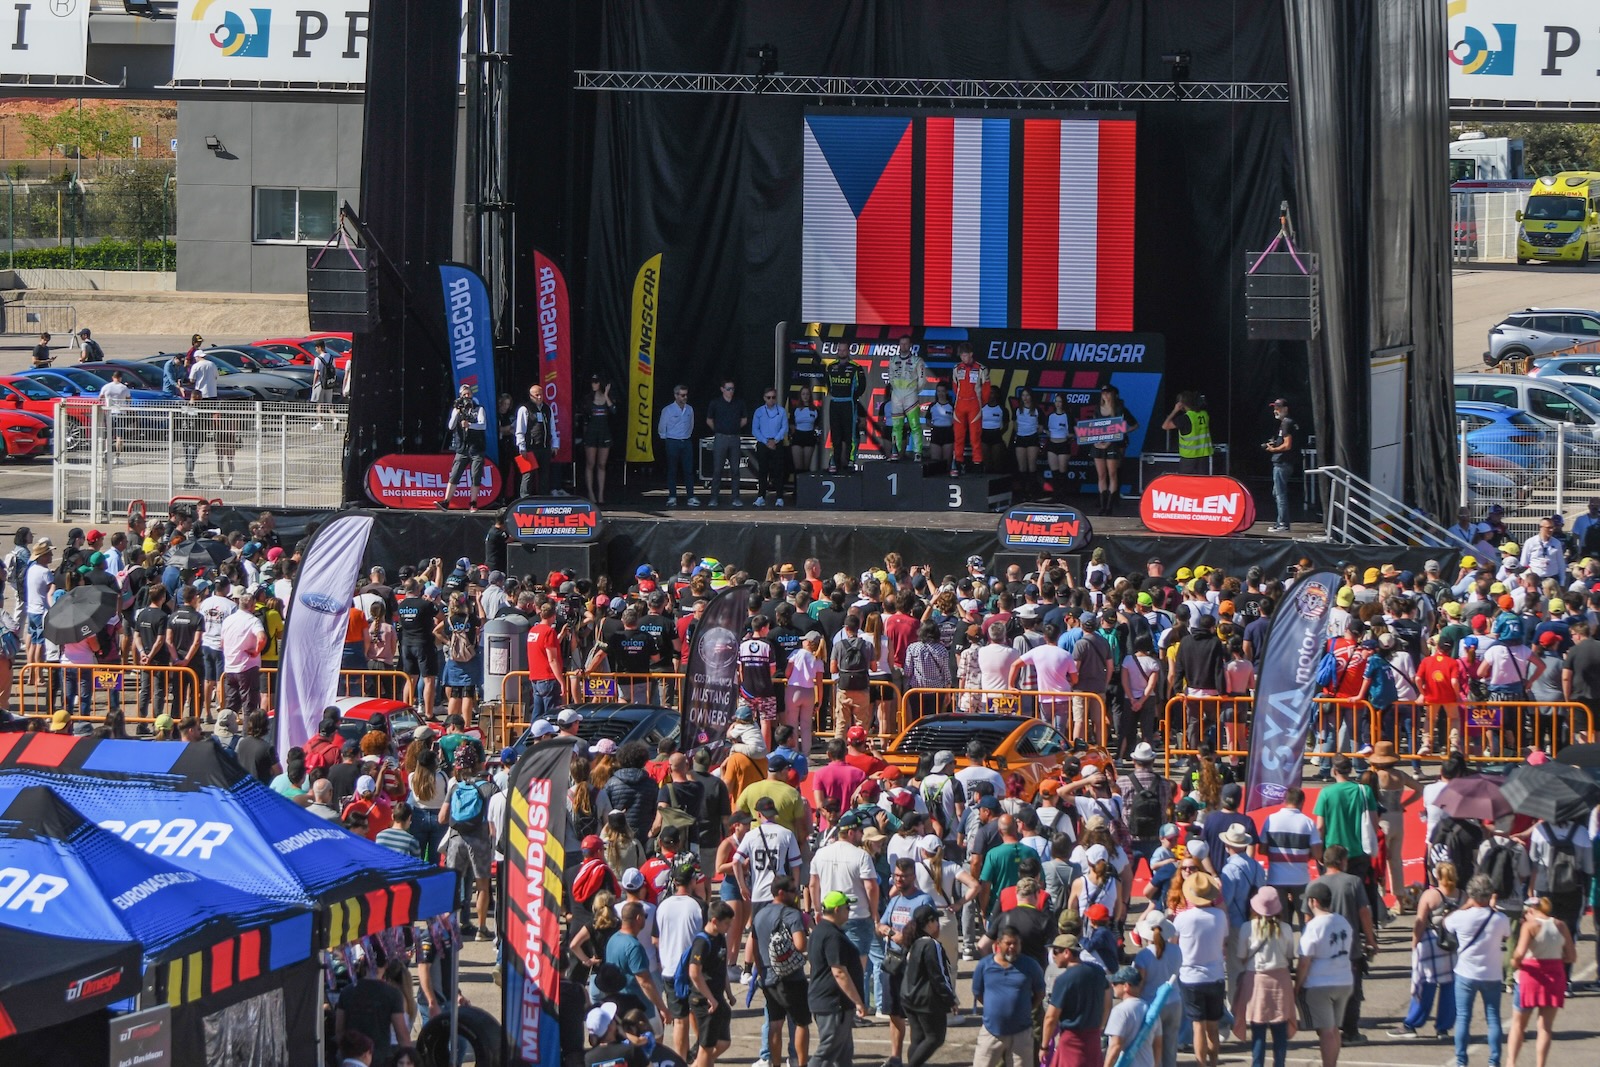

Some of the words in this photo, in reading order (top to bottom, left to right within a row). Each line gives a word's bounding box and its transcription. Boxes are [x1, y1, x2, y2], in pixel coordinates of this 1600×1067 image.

[639, 267, 657, 355] NASCAR
[821, 341, 860, 355] EUO
[872, 344, 920, 356] NASR
[987, 341, 1047, 361] EURO
[1069, 342, 1146, 363] NASCAR
[1074, 420, 1127, 437] WHELEN
[821, 480, 836, 504] 2
[886, 473, 898, 496] 1
[382, 489, 445, 498] ENGINEERING
[948, 484, 962, 508] 3
[1151, 489, 1237, 515] WHELEN
[544, 506, 572, 515] NASCAR
[1152, 512, 1191, 521] ENGINEERING
[1191, 514, 1221, 522] COMPANY
[1221, 515, 1234, 523] INC.
[513, 511, 597, 529] WHELEN
[1034, 515, 1058, 523] NASCAR
[534, 527, 551, 535] EURO
[552, 527, 577, 535] SERIES
[1005, 518, 1080, 537] WHELEN
[1021, 535, 1038, 543] EURO
[1038, 535, 1059, 544] SERIES
[399, 606, 418, 614] orion
[640, 623, 663, 632] orion
[621, 638, 644, 647] orion
[1294, 627, 1317, 685] motor
[98, 672, 119, 682] SPV
[589, 679, 610, 689] SPV
[691, 687, 731, 705] MUSTANG
[992, 698, 1015, 709] SPV
[689, 707, 728, 726] OWNERS
[1471, 708, 1497, 719] SPV
[521, 778, 551, 1062] MERCHANDISE
